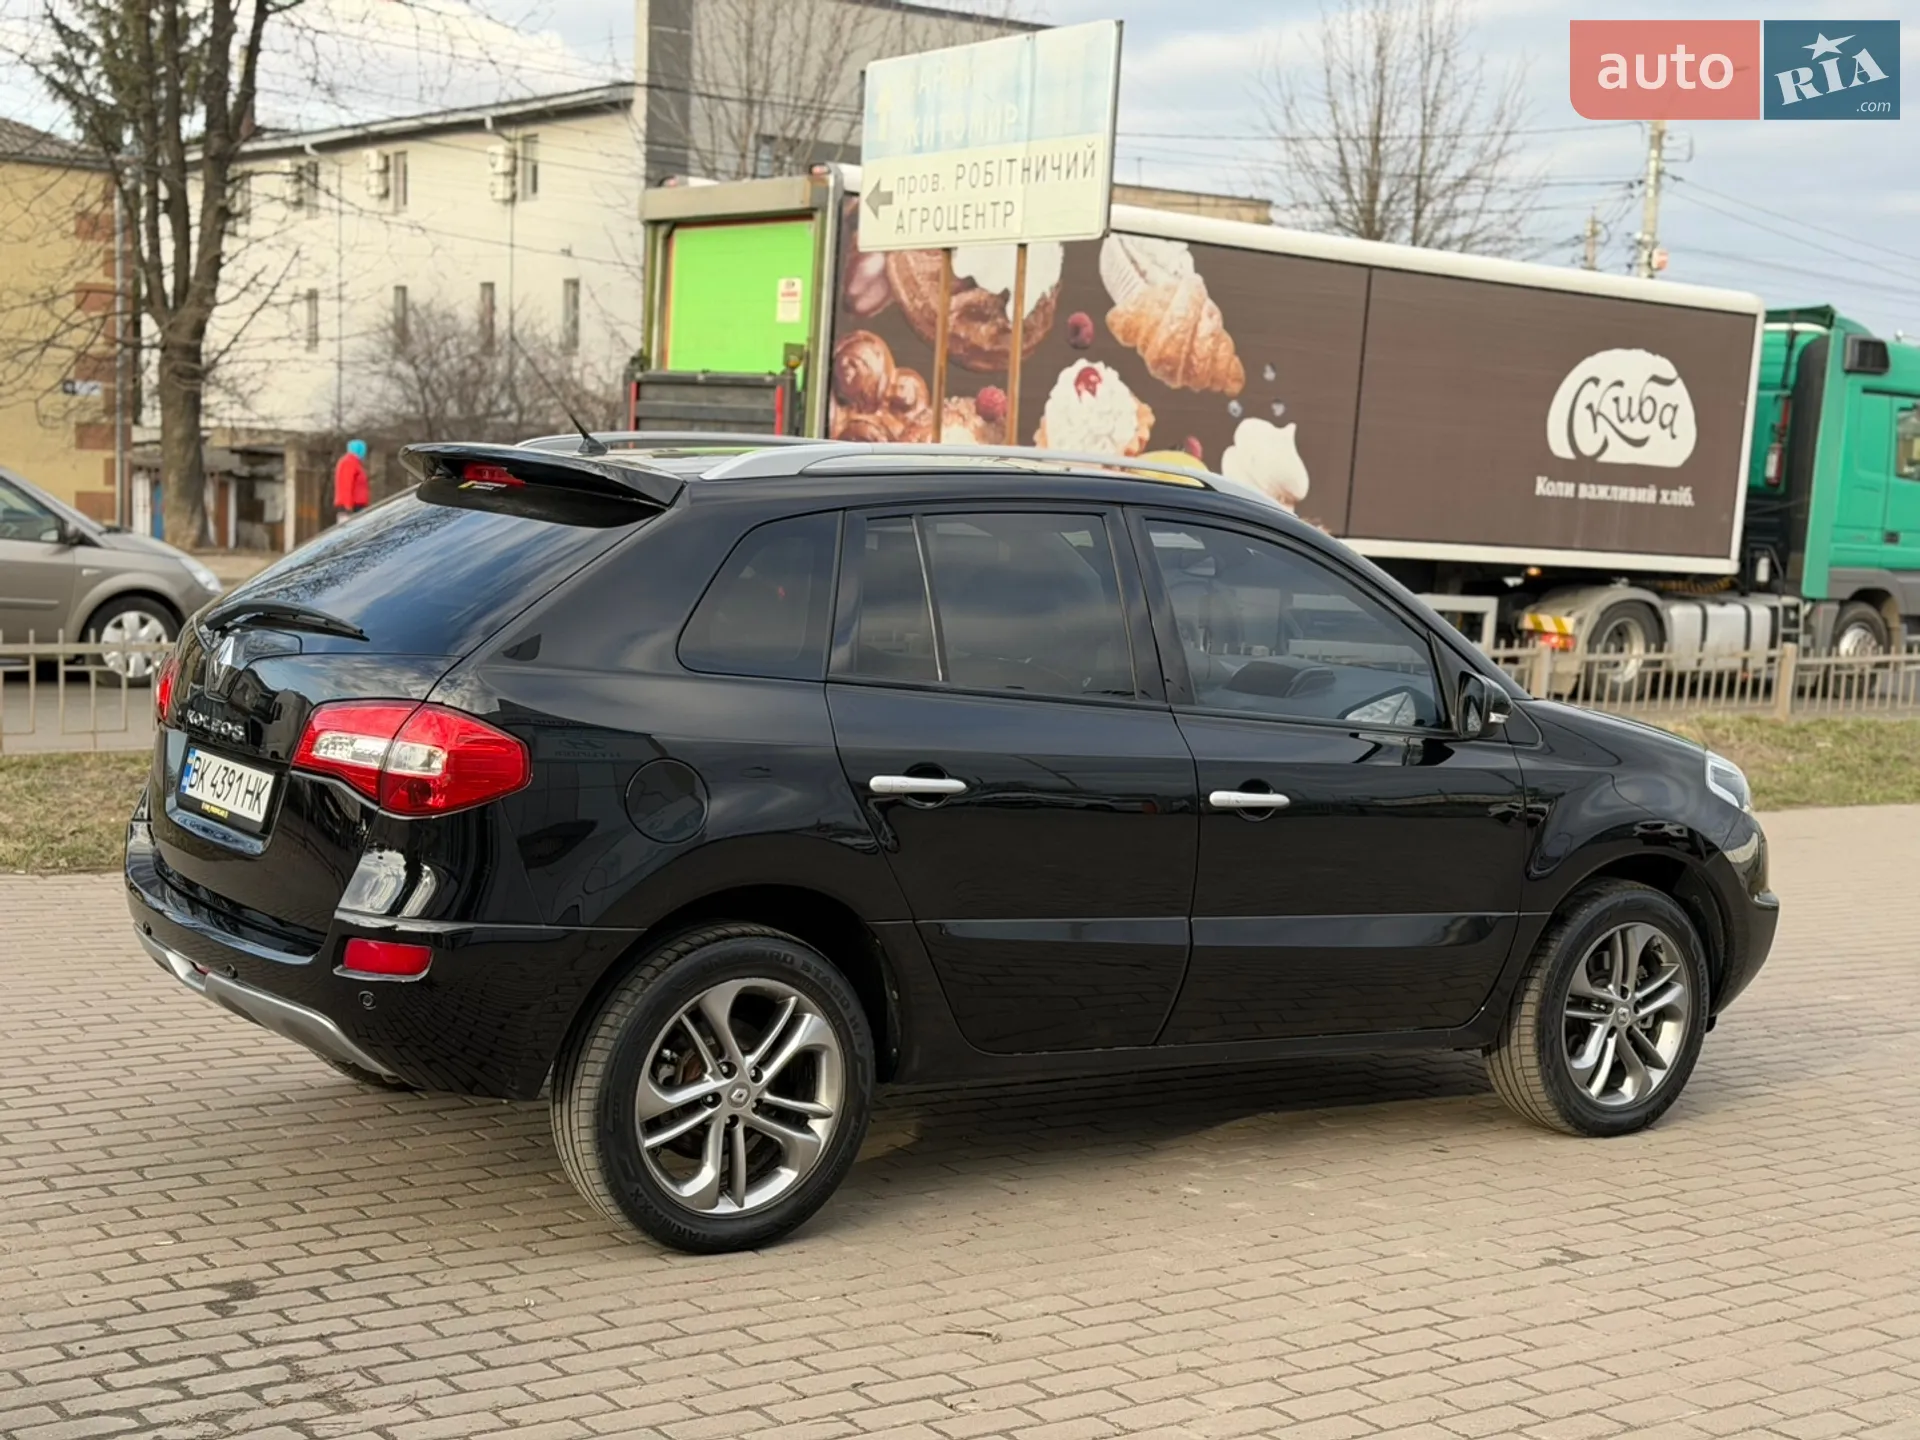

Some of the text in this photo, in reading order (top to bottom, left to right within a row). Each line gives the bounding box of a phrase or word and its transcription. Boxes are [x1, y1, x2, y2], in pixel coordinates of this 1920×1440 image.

[896, 142, 1096, 200] пров. РОБІТНИЧИЙ
[895, 201, 1015, 235] АГРОЦЕНТР
[1567, 374, 1679, 460] Скиба
[1535, 476, 1575, 498] Коли
[1578, 483, 1657, 504] важливий
[187, 709, 245, 740] KOLEOS
[189, 756, 212, 793] BK
[210, 764, 244, 806] 4391
[241, 774, 269, 814] HK
